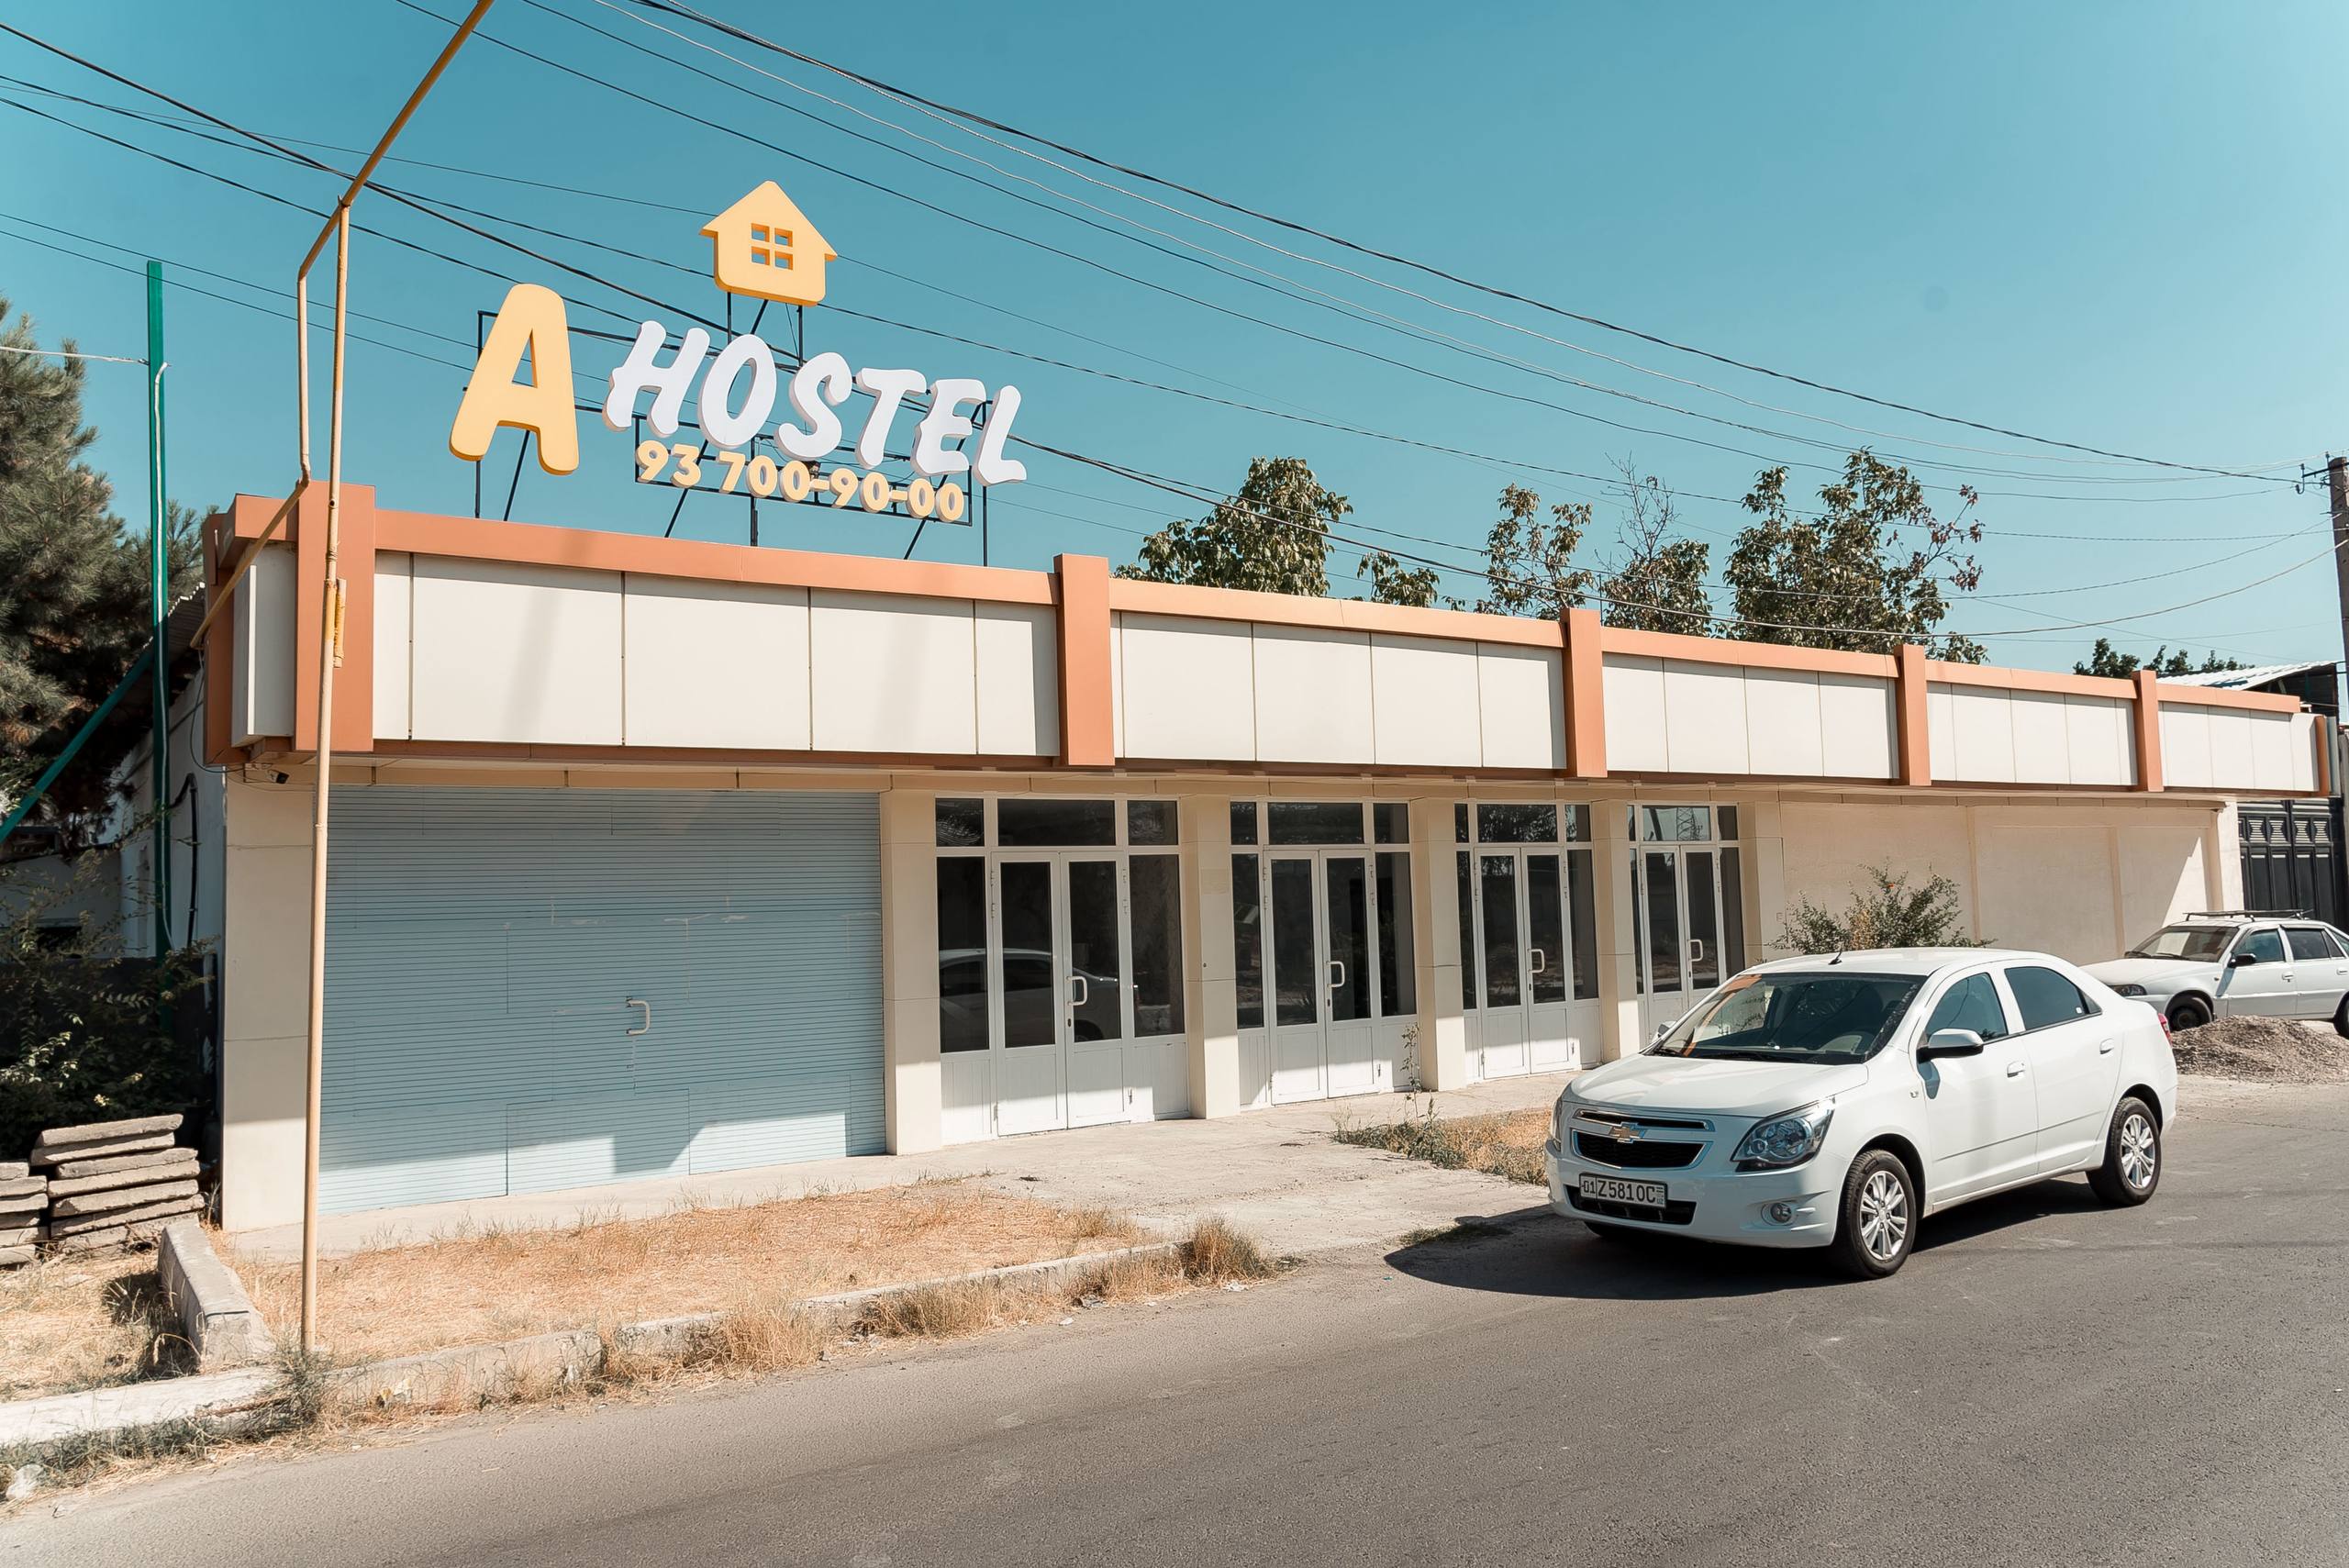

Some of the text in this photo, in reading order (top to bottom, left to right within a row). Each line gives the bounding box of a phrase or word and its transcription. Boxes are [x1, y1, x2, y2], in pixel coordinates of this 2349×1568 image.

[450, 284, 1027, 485] A HOSTEL
[636, 439, 964, 522] 93 700-90-00
[1583, 1180, 1596, 1194] 01
